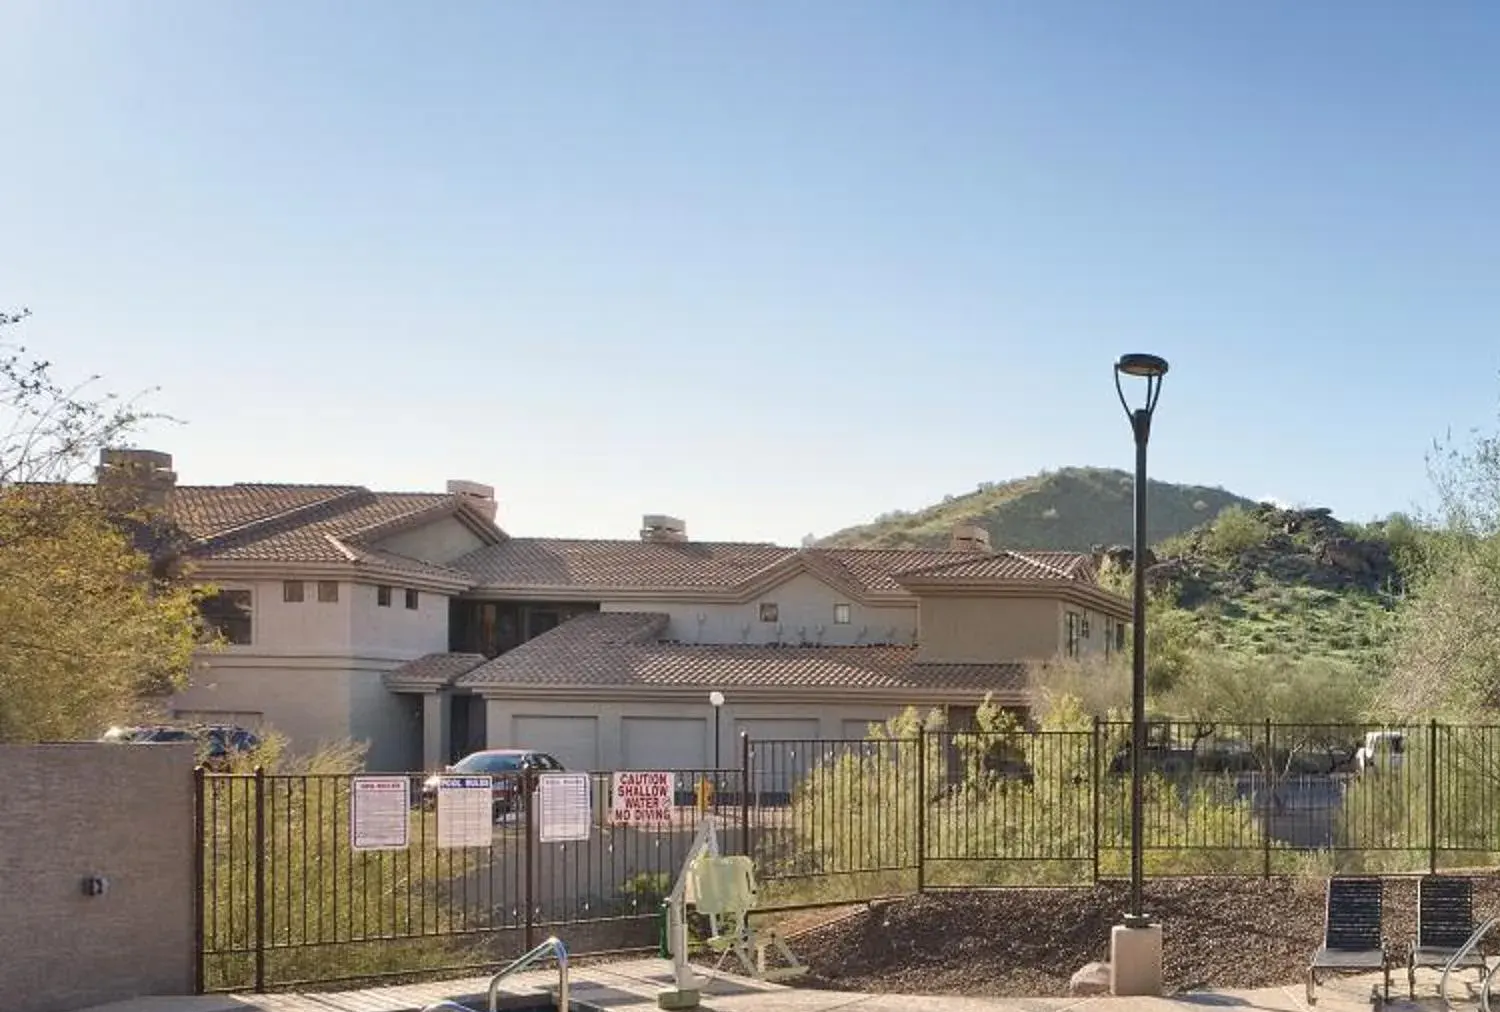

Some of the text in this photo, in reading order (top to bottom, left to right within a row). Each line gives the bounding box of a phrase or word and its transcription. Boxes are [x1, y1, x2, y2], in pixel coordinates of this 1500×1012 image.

[619, 773, 667, 785] CAUTION
[617, 785, 667, 797] SHALLOW
[625, 797, 659, 809] WATER
[615, 809, 671, 821] NO DIVING
